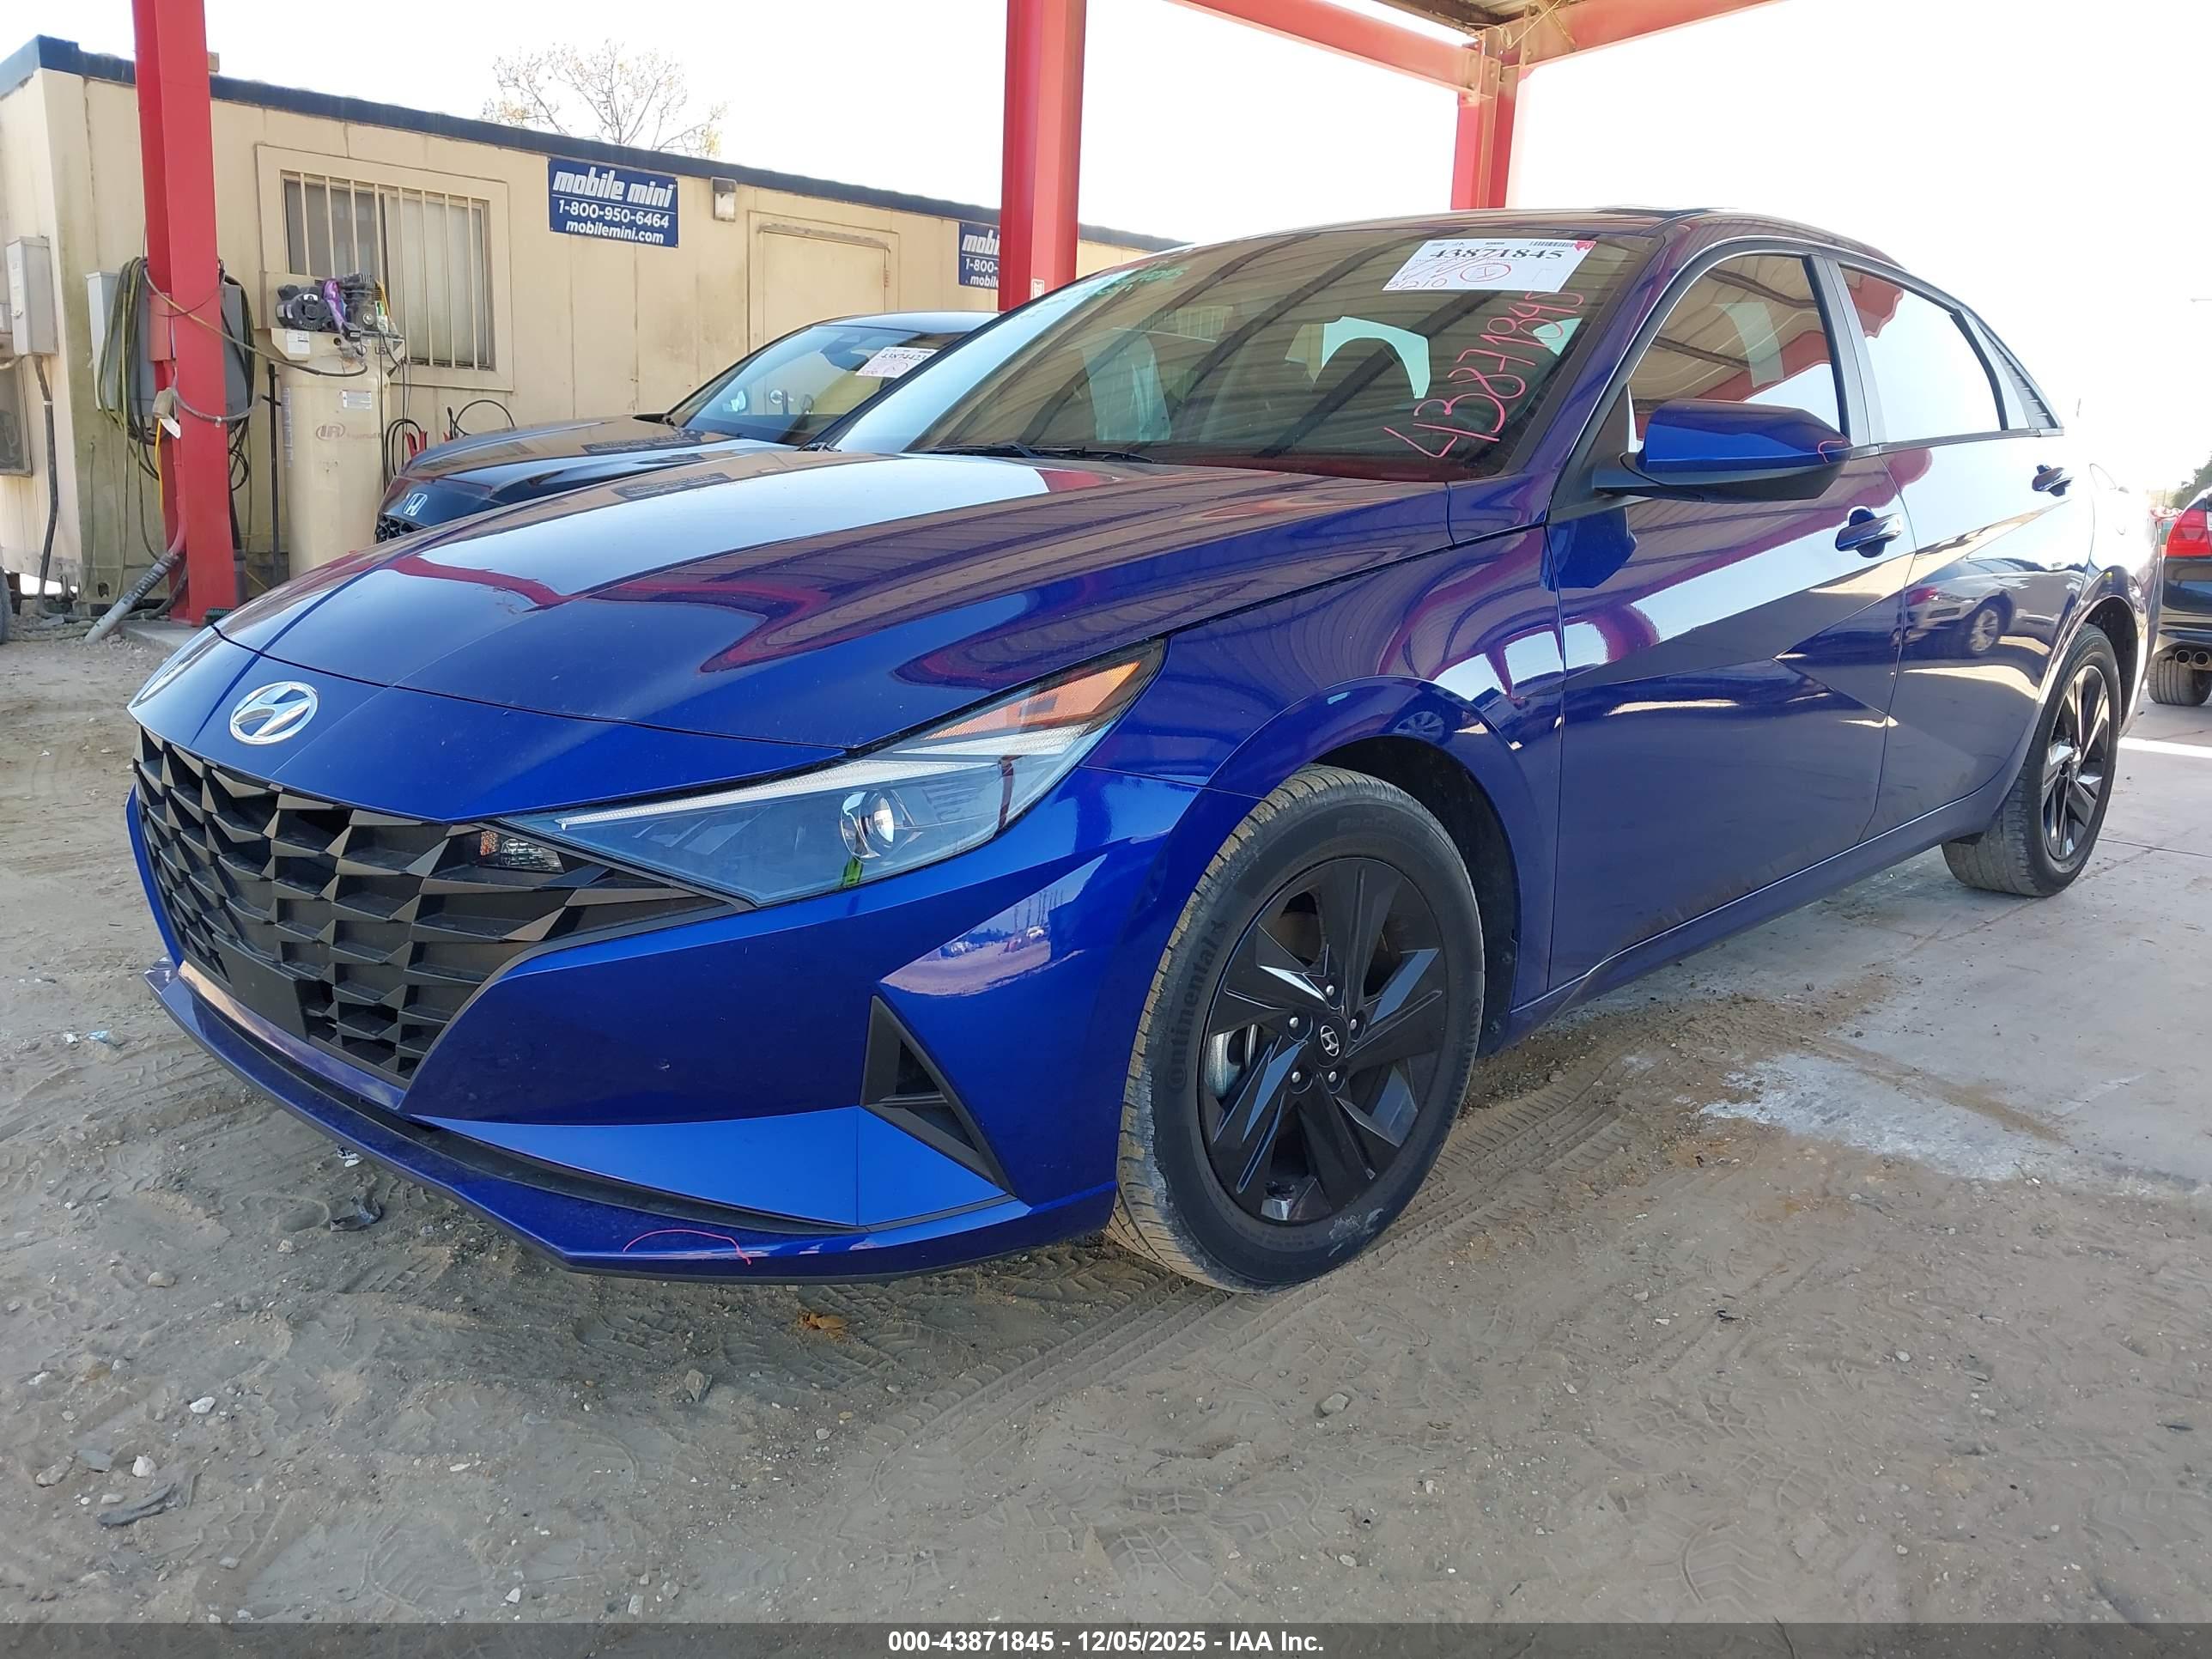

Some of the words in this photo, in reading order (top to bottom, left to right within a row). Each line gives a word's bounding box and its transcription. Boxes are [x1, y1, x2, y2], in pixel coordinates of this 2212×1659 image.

[553, 167, 625, 201] mobile
[627, 181, 674, 208] mini
[558, 199, 669, 228] 1-800-950-6464
[566, 220, 664, 244] mobilemini.com
[962, 229, 1000, 255] mobi
[965, 258, 999, 273] 1-800-
[1430, 247, 1566, 259] 43871845
